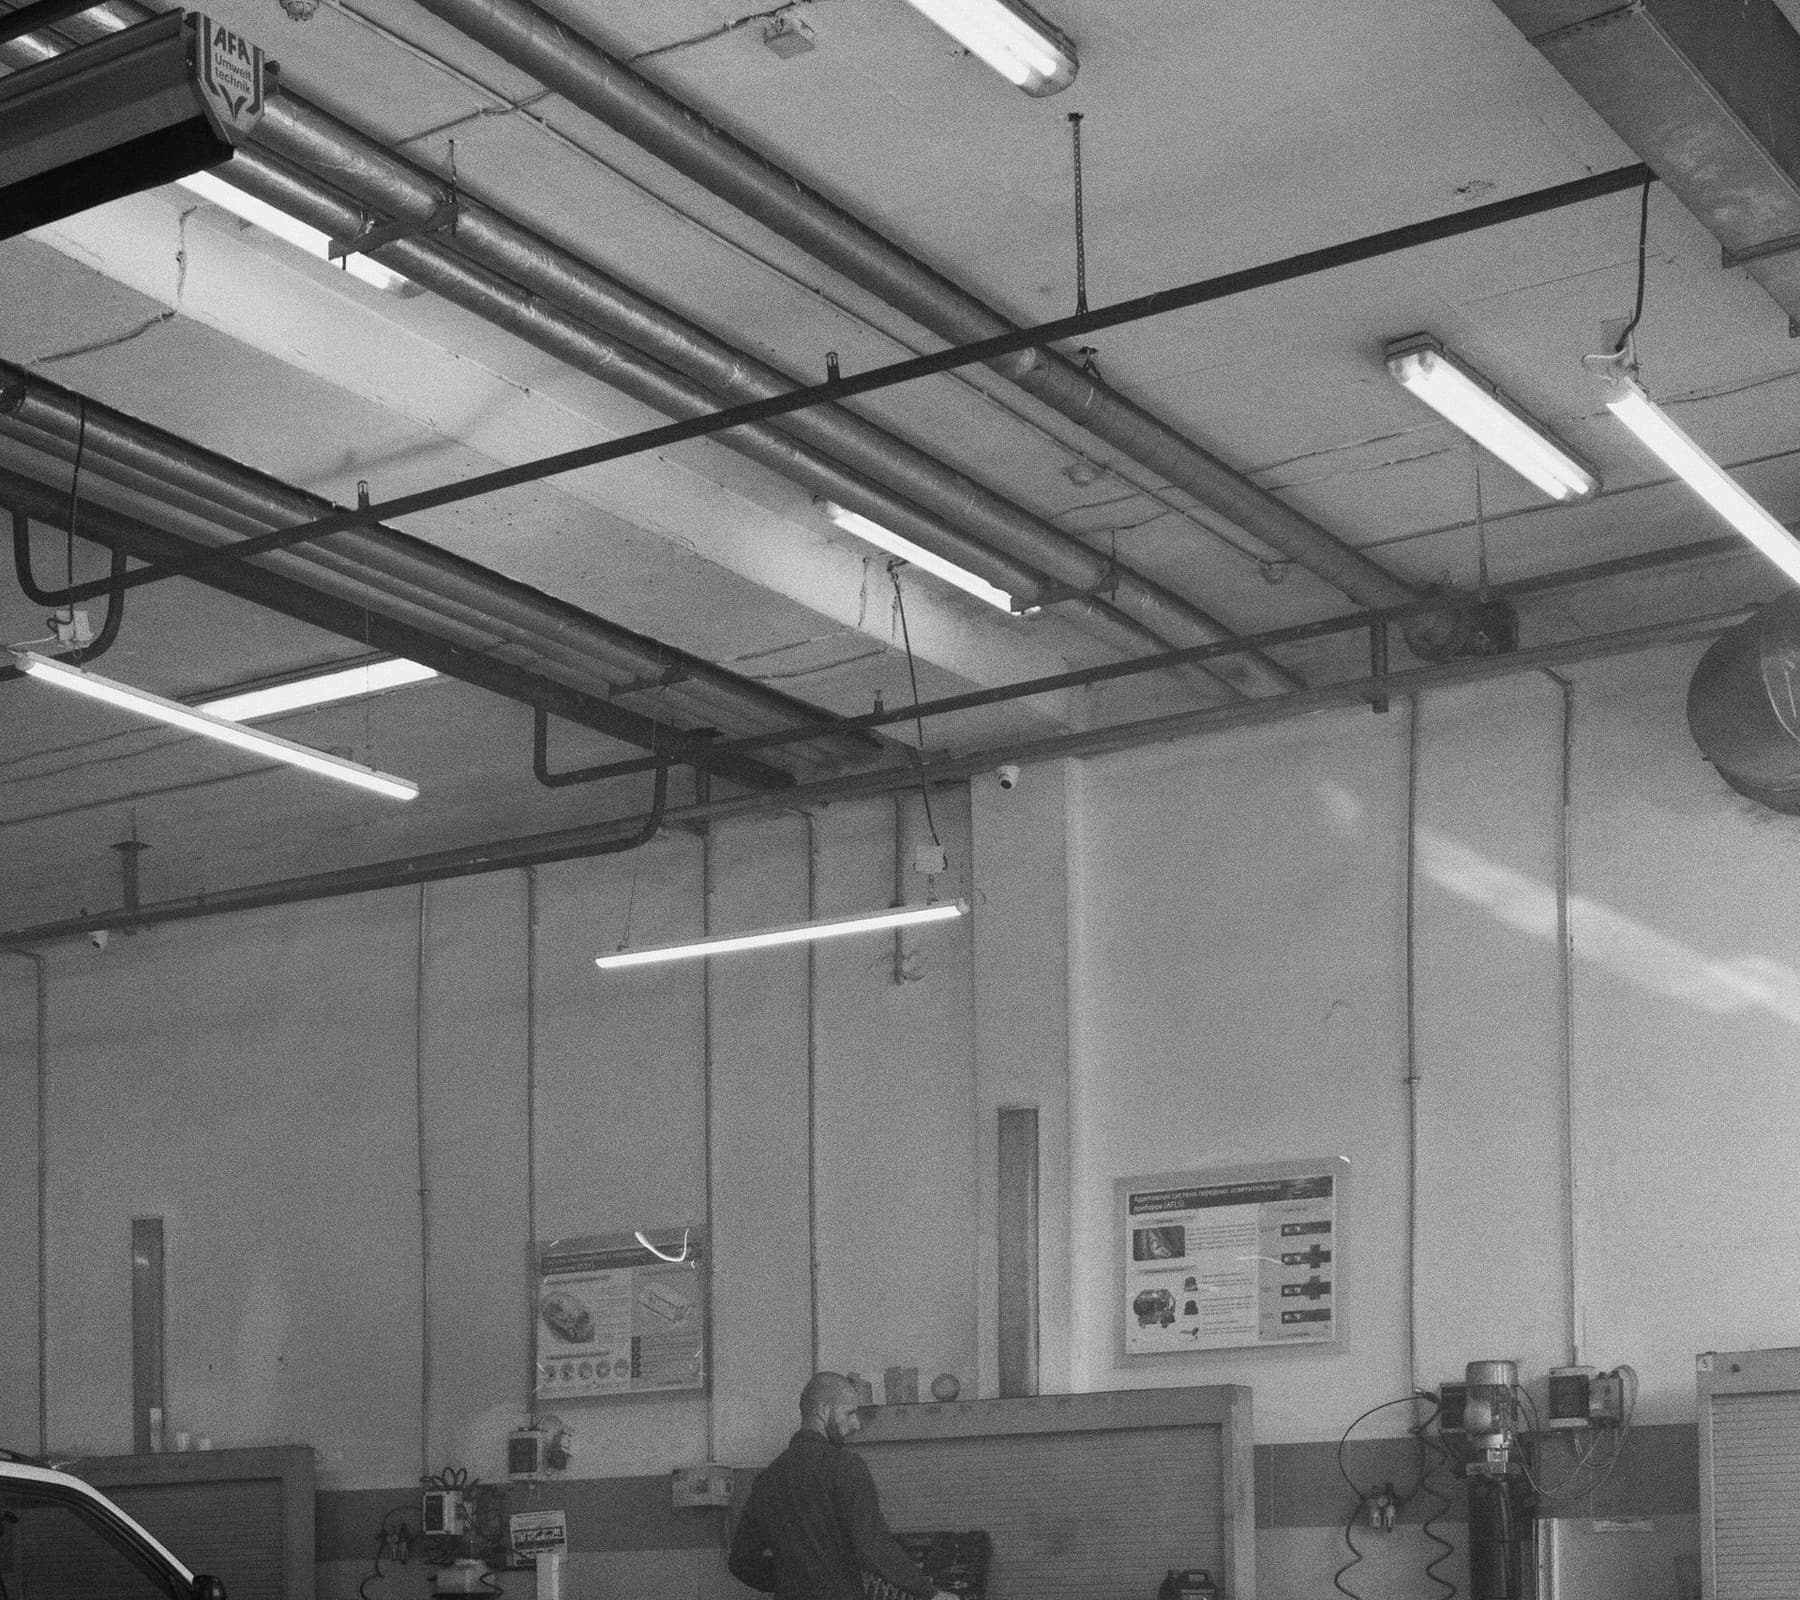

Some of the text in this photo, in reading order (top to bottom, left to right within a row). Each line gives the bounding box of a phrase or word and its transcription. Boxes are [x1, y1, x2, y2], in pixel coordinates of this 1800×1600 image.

[213, 26, 251, 65] AFA
[215, 53, 251, 82] Umwelt
[215, 66, 251, 92] technik
